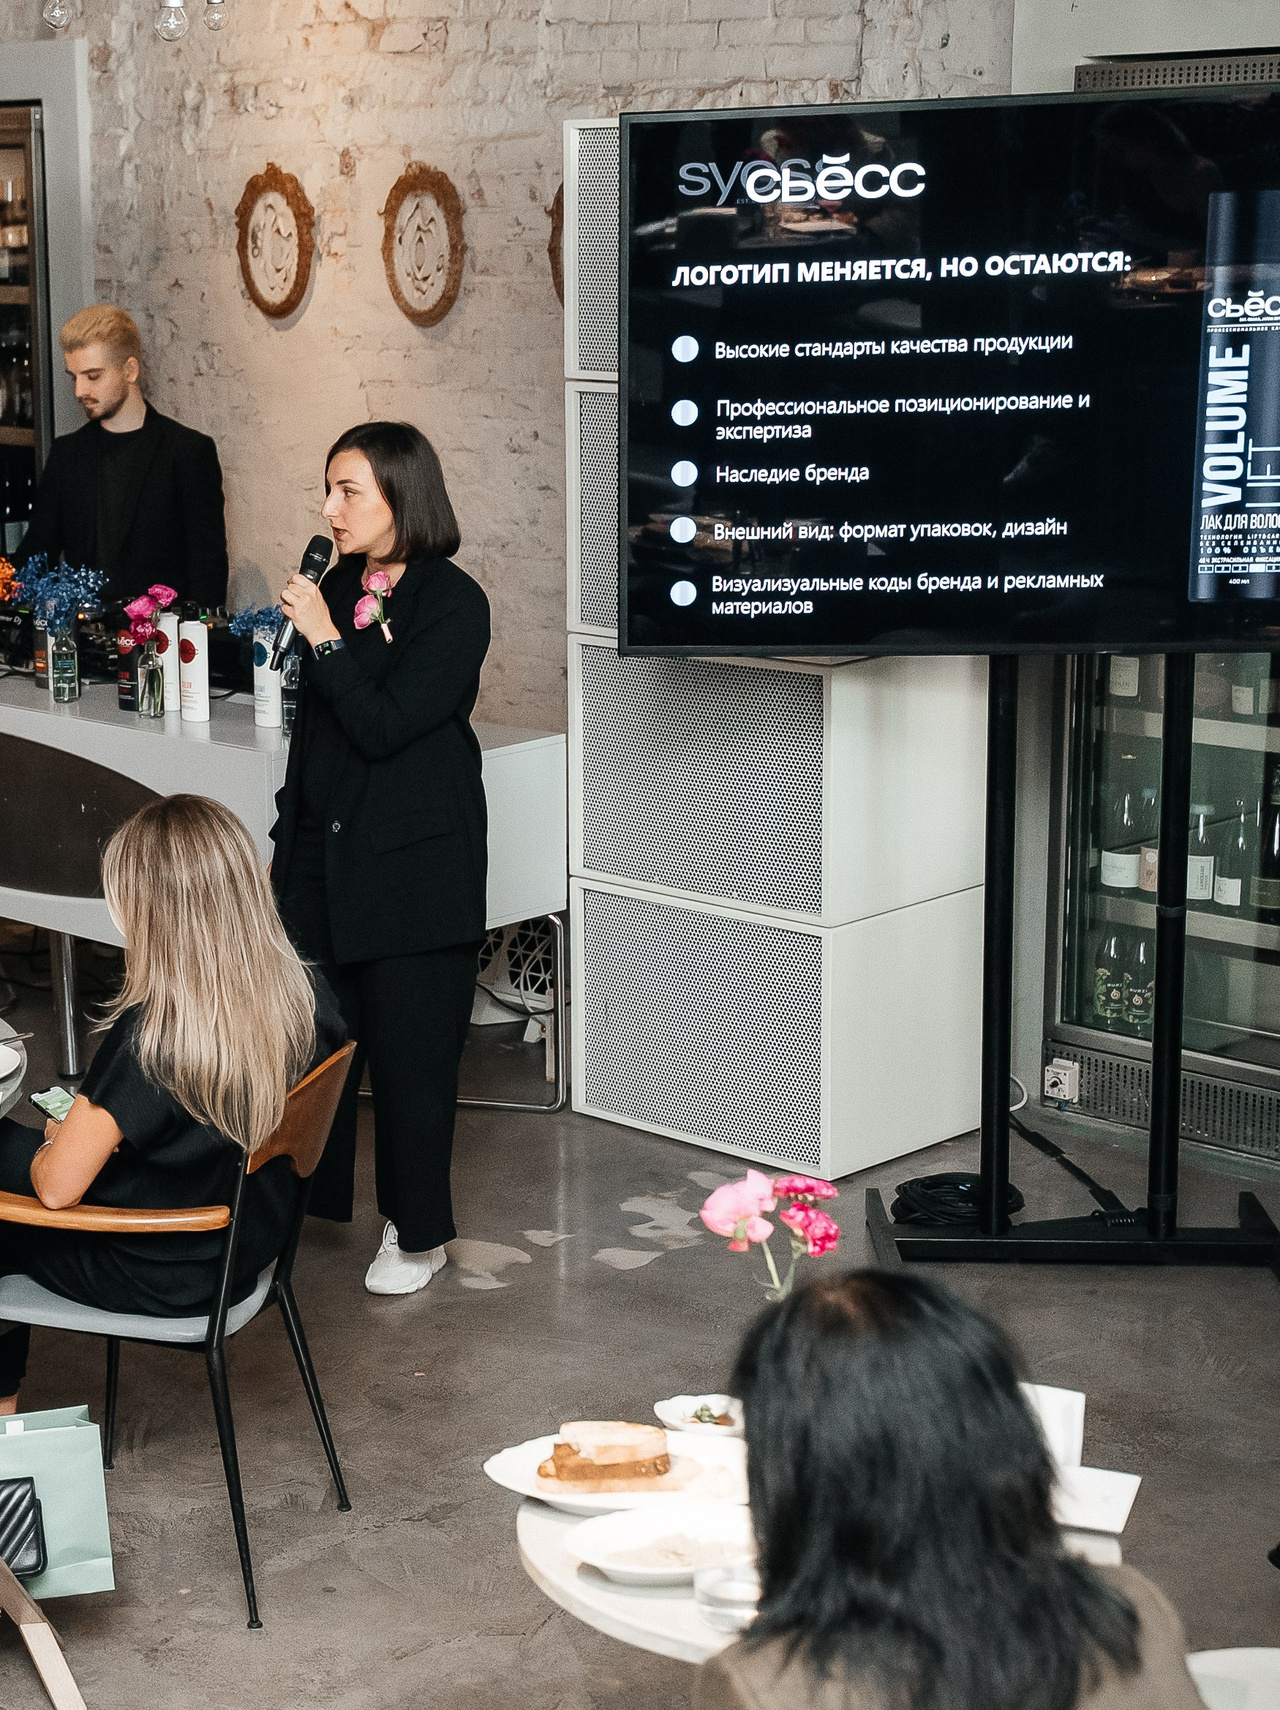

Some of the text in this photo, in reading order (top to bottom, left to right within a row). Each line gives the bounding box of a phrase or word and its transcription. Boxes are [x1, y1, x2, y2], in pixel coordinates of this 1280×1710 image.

[672, 251, 1132, 287] ЛОГОТИП МЕНЯЕТСЯ, НО ОСТАЮТСЯ:
[715, 333, 1073, 359] Высокие стандарты качества продукции
[717, 394, 1091, 421] Профессиональное позиционирование и
[715, 424, 812, 443] экспертиза
[1201, 344, 1250, 508] VOLUME
[716, 464, 870, 486] Наследие бренда
[714, 517, 1068, 543] Внешний вид: формат упаковок, дизайн
[1200, 514, 1223, 530] ЛАК
[1223, 513, 1248, 531] ДЛЯ
[712, 572, 1105, 596] Визуализуальные коды бренда и рекламных
[711, 600, 814, 618] материалов
